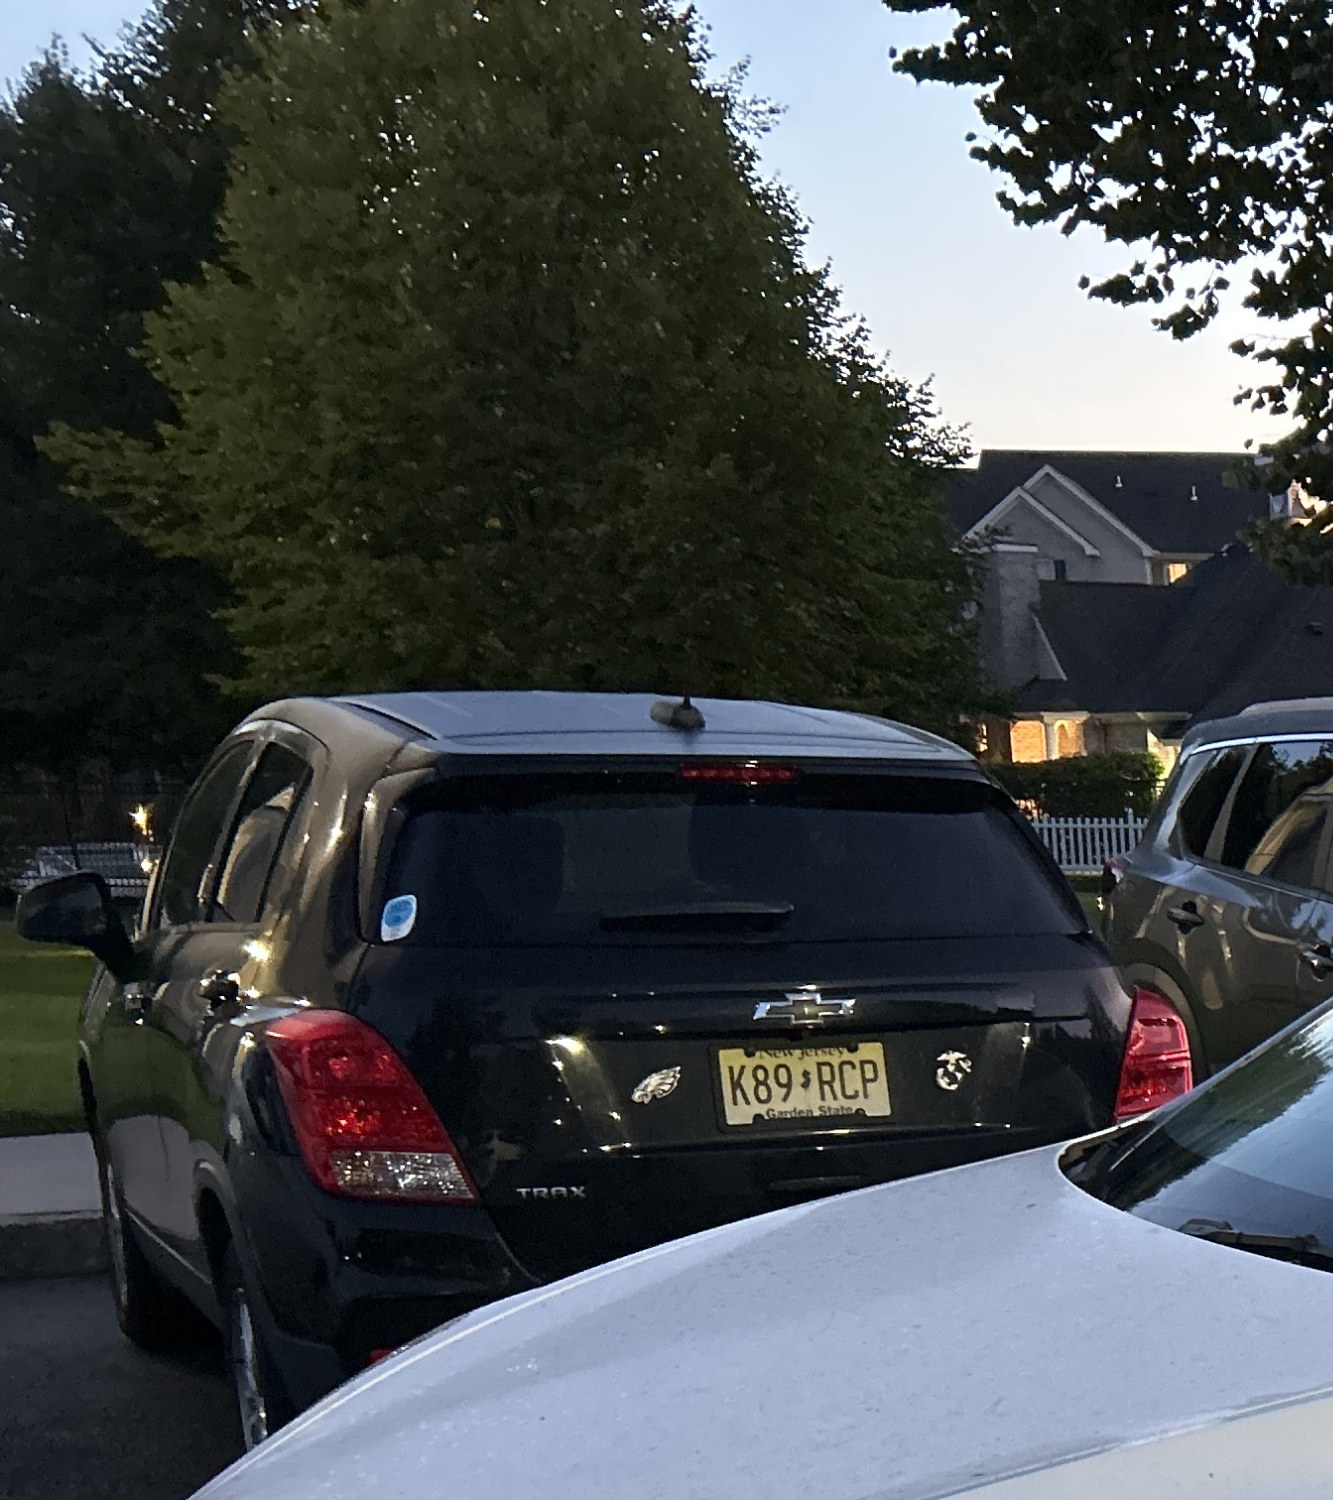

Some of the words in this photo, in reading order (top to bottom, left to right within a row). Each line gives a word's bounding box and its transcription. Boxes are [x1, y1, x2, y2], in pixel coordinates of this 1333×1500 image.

[728, 1063, 793, 1106] K89
[816, 1059, 879, 1101] RCP
[766, 1107, 814, 1119] Garden
[818, 1105, 853, 1116] State
[516, 1186, 587, 1200] TRAX
